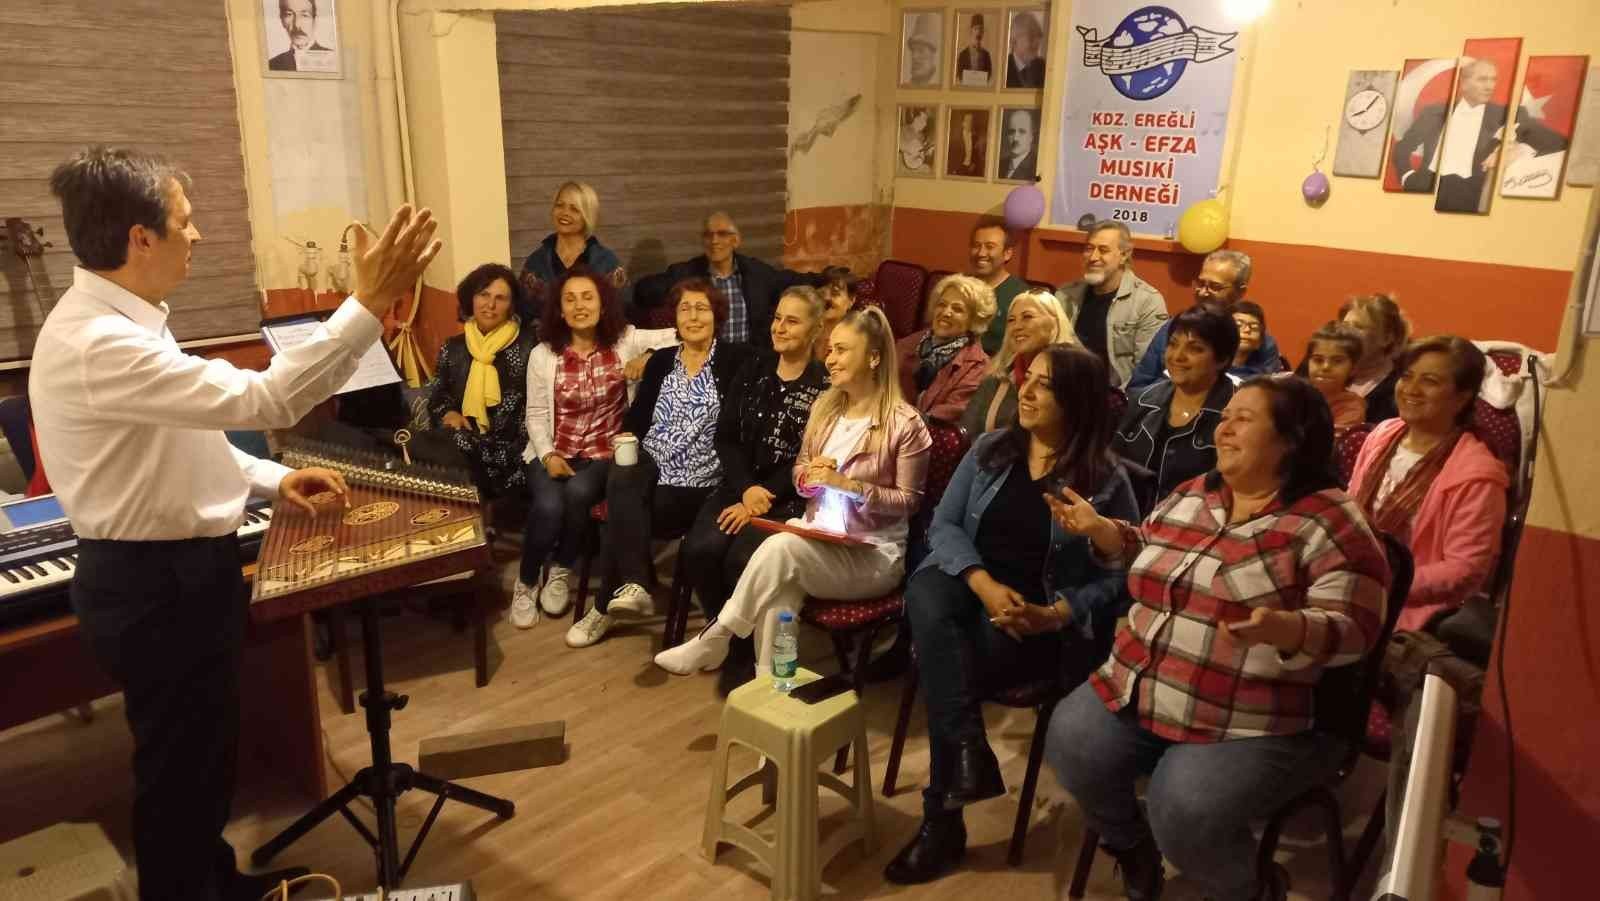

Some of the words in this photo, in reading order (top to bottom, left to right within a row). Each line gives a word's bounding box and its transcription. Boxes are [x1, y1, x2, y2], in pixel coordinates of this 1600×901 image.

[1091, 112, 1128, 127] KDZ.
[1134, 110, 1196, 128] EREĞLİ
[1084, 133, 1123, 155] AŞK
[1144, 135, 1197, 154] EFZA
[1099, 158, 1174, 179] MUSIKİ
[1089, 182, 1179, 205] DERNEĞİ
[1112, 209, 1148, 222] 2018
